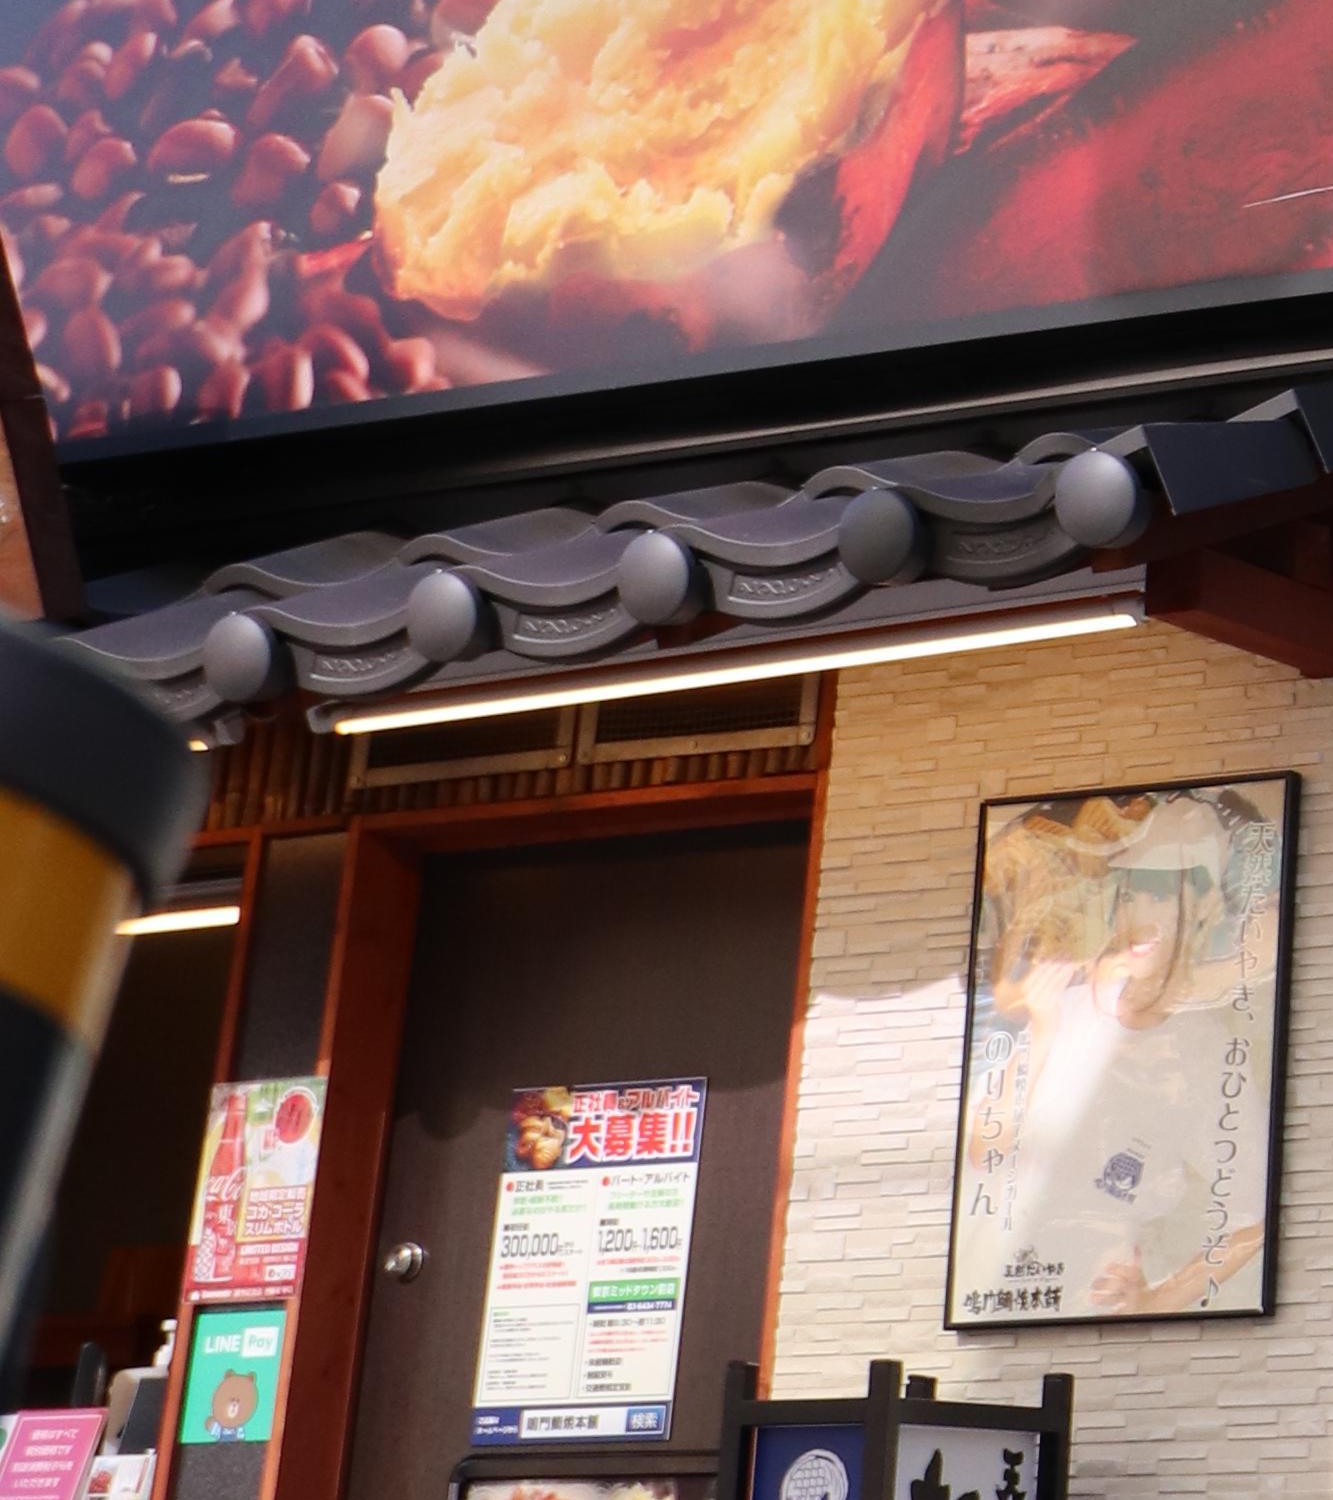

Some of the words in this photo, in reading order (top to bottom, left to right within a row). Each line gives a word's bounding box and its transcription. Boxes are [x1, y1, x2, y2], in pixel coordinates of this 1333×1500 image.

[569, 1110, 695, 1161] 大募集!!
[968, 1030, 1015, 1217] のりちゃん
[204, 1334, 242, 1355] LINE
[245, 1331, 275, 1352] Pay
